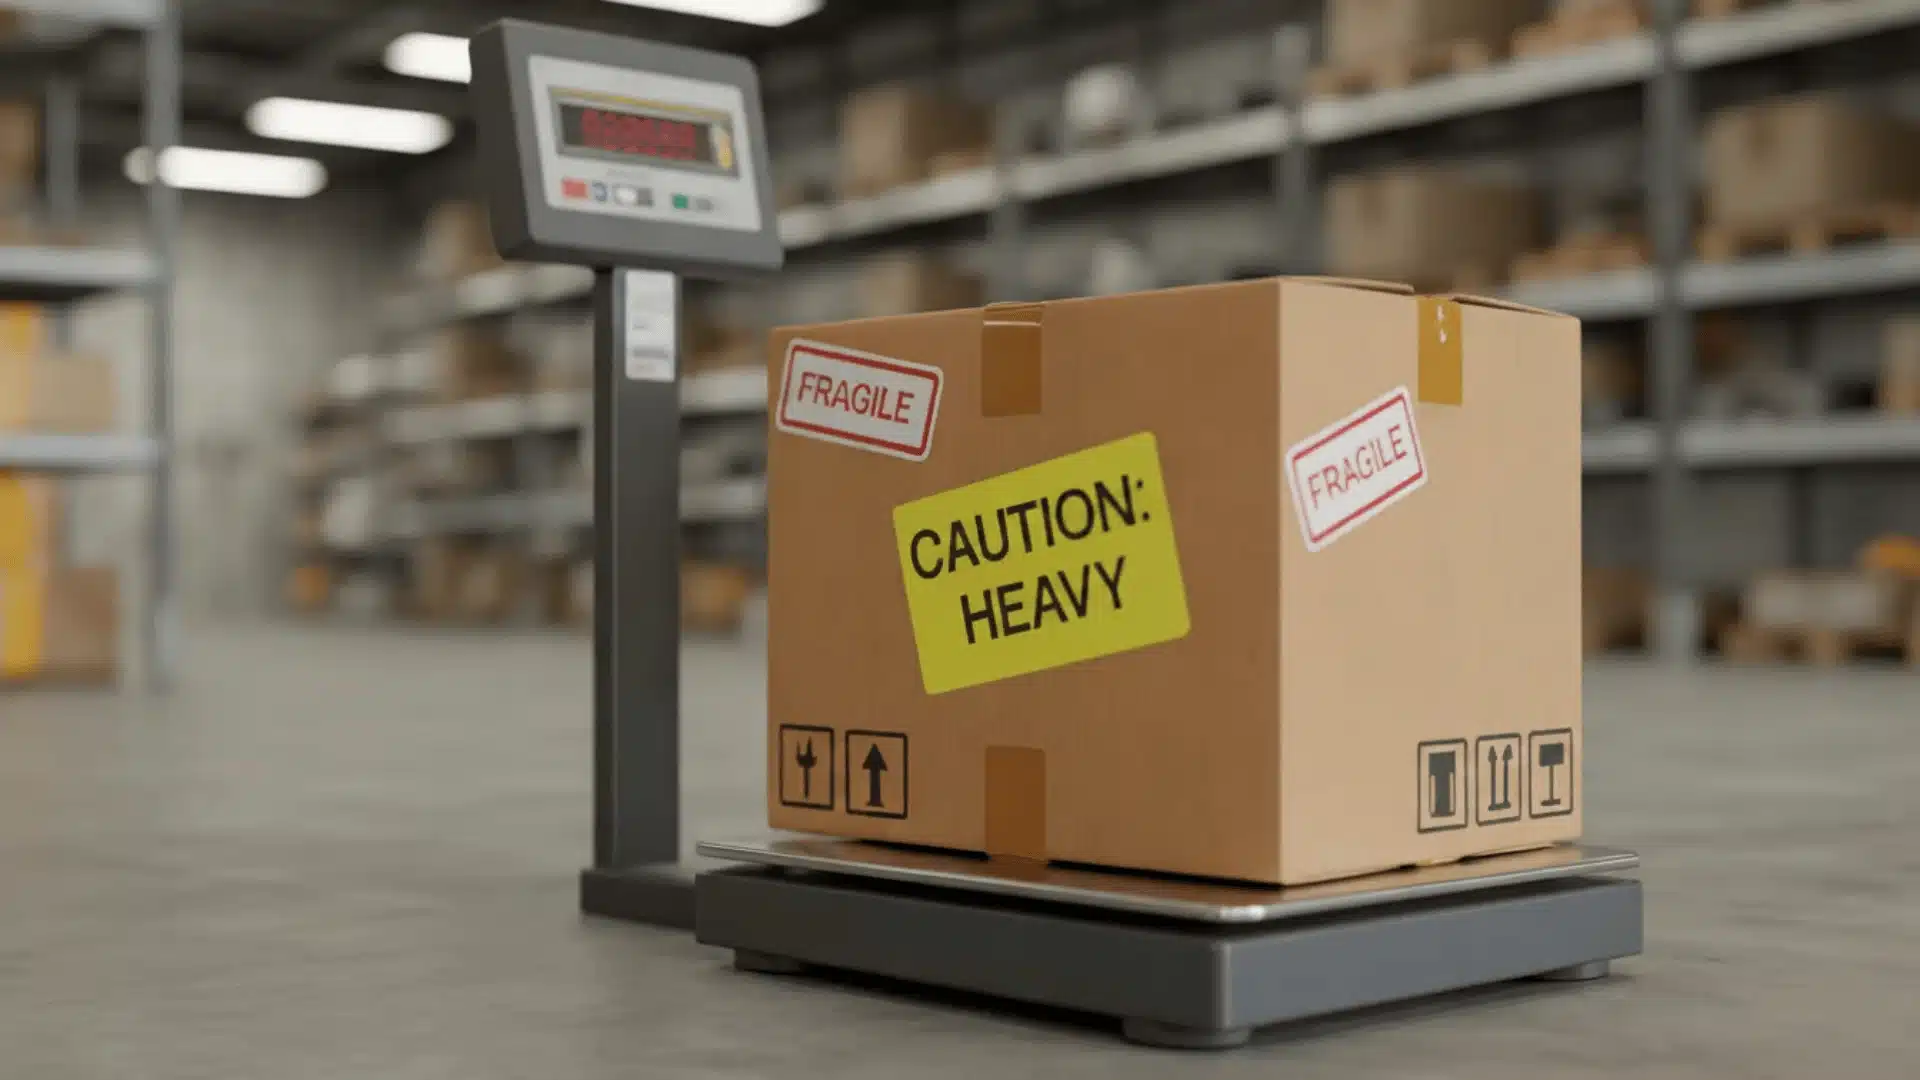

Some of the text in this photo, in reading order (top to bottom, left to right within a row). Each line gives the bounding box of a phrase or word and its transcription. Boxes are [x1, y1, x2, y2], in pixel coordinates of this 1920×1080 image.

[798, 371, 915, 425] FRAGILE
[1307, 424, 1407, 511] FRAGILE
[910, 474, 1151, 580] CAUTION:
[960, 555, 1126, 645] HEAVY
